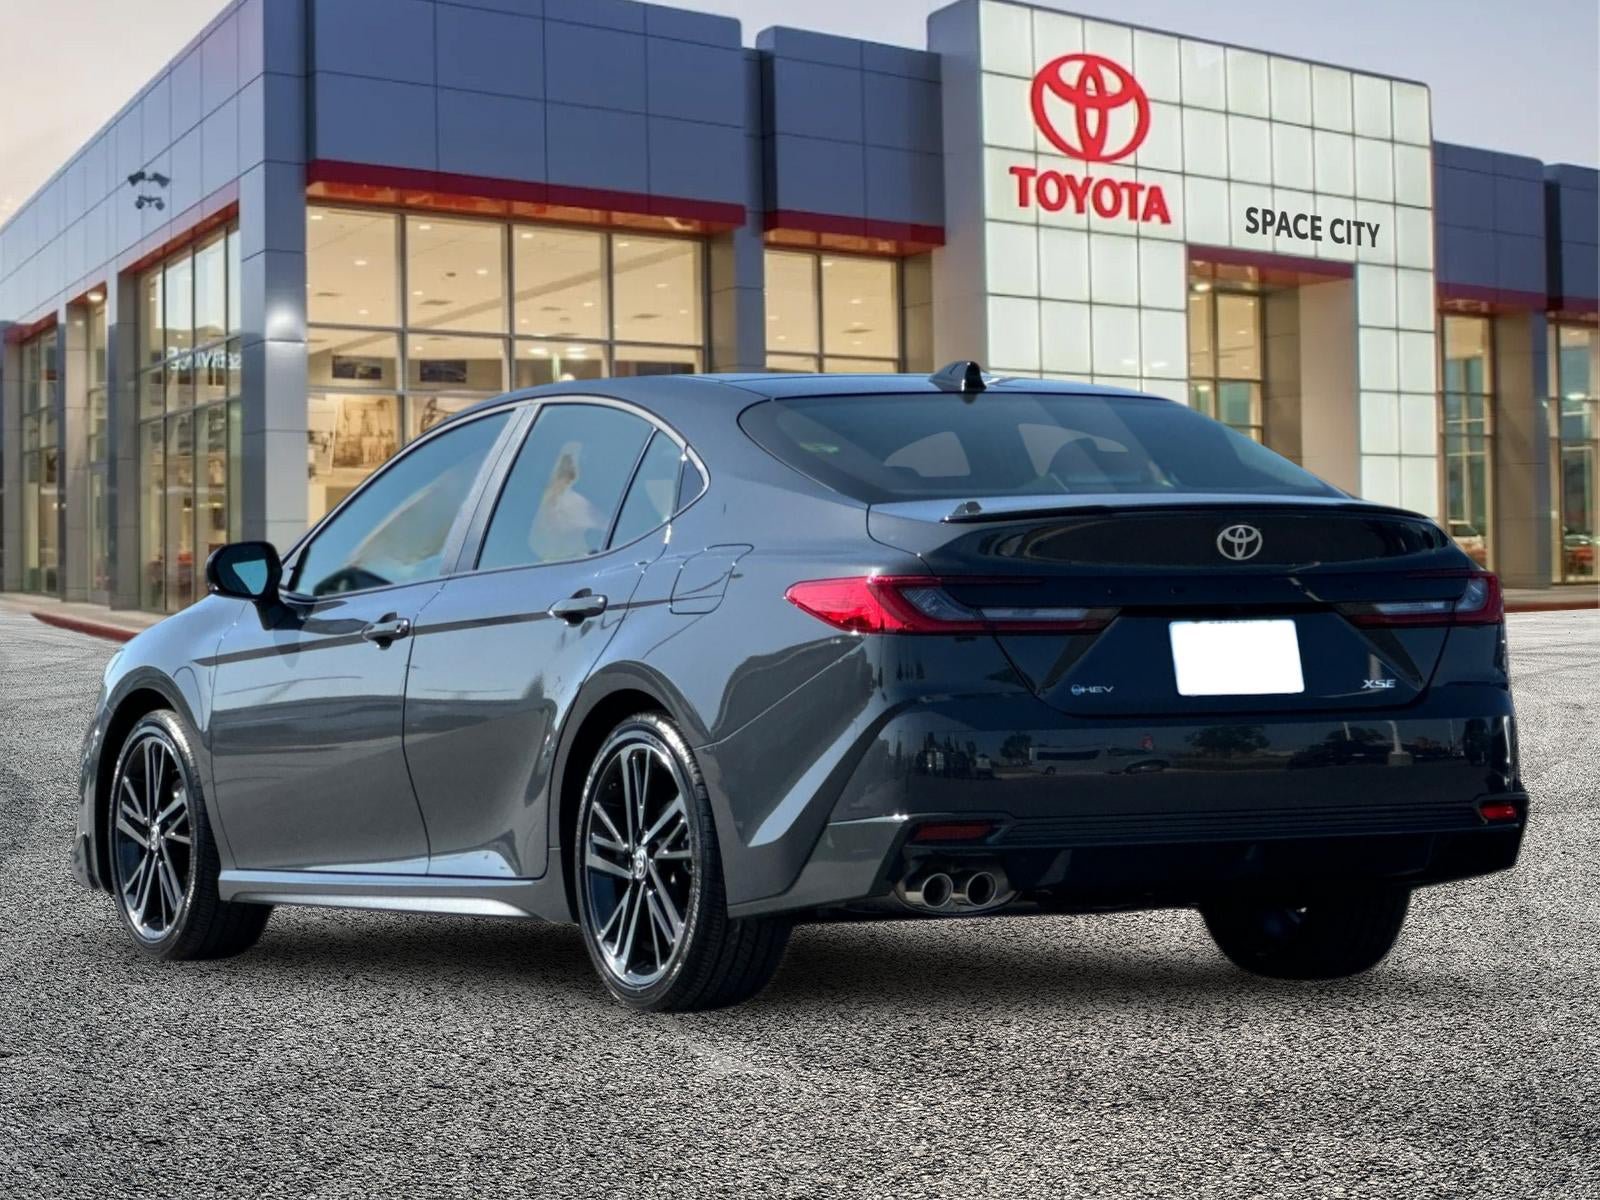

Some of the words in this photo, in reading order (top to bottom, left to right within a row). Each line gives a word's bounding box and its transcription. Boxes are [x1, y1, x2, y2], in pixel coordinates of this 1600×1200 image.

[1009, 166, 1171, 224] TOYOTA
[1245, 206, 1322, 241] SPACE
[1329, 218, 1380, 248] CITY
[1361, 679, 1396, 689] XSE
